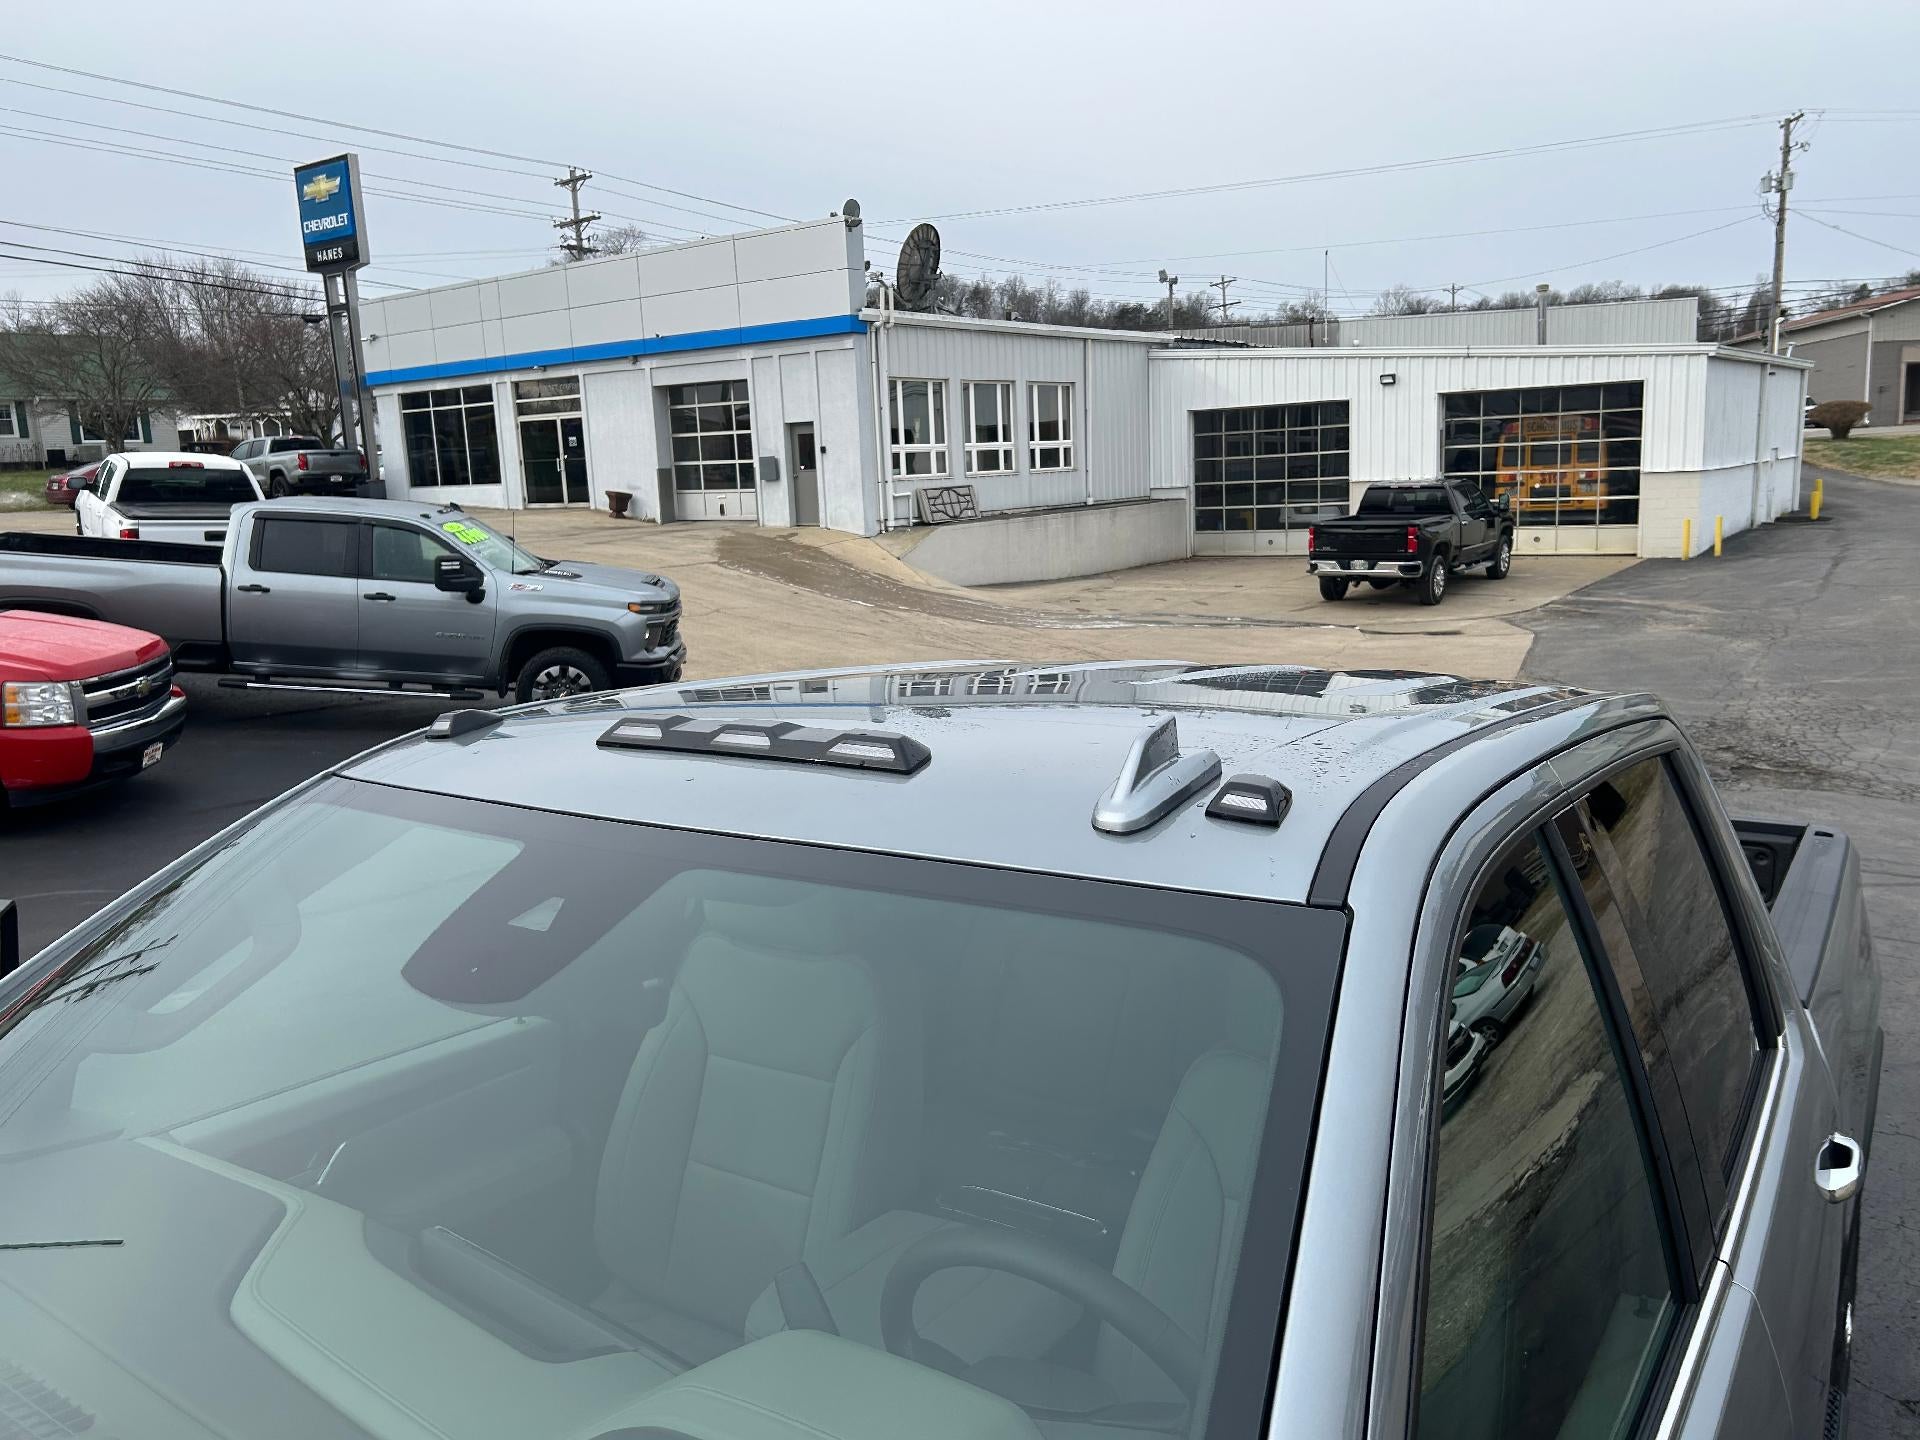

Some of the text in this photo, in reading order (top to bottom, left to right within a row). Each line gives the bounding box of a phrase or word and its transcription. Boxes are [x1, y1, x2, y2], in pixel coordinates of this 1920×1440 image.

[303, 212, 348, 233] CHEVROLET
[317, 247, 343, 262] HANES
[1539, 472, 1567, 484] STOP
